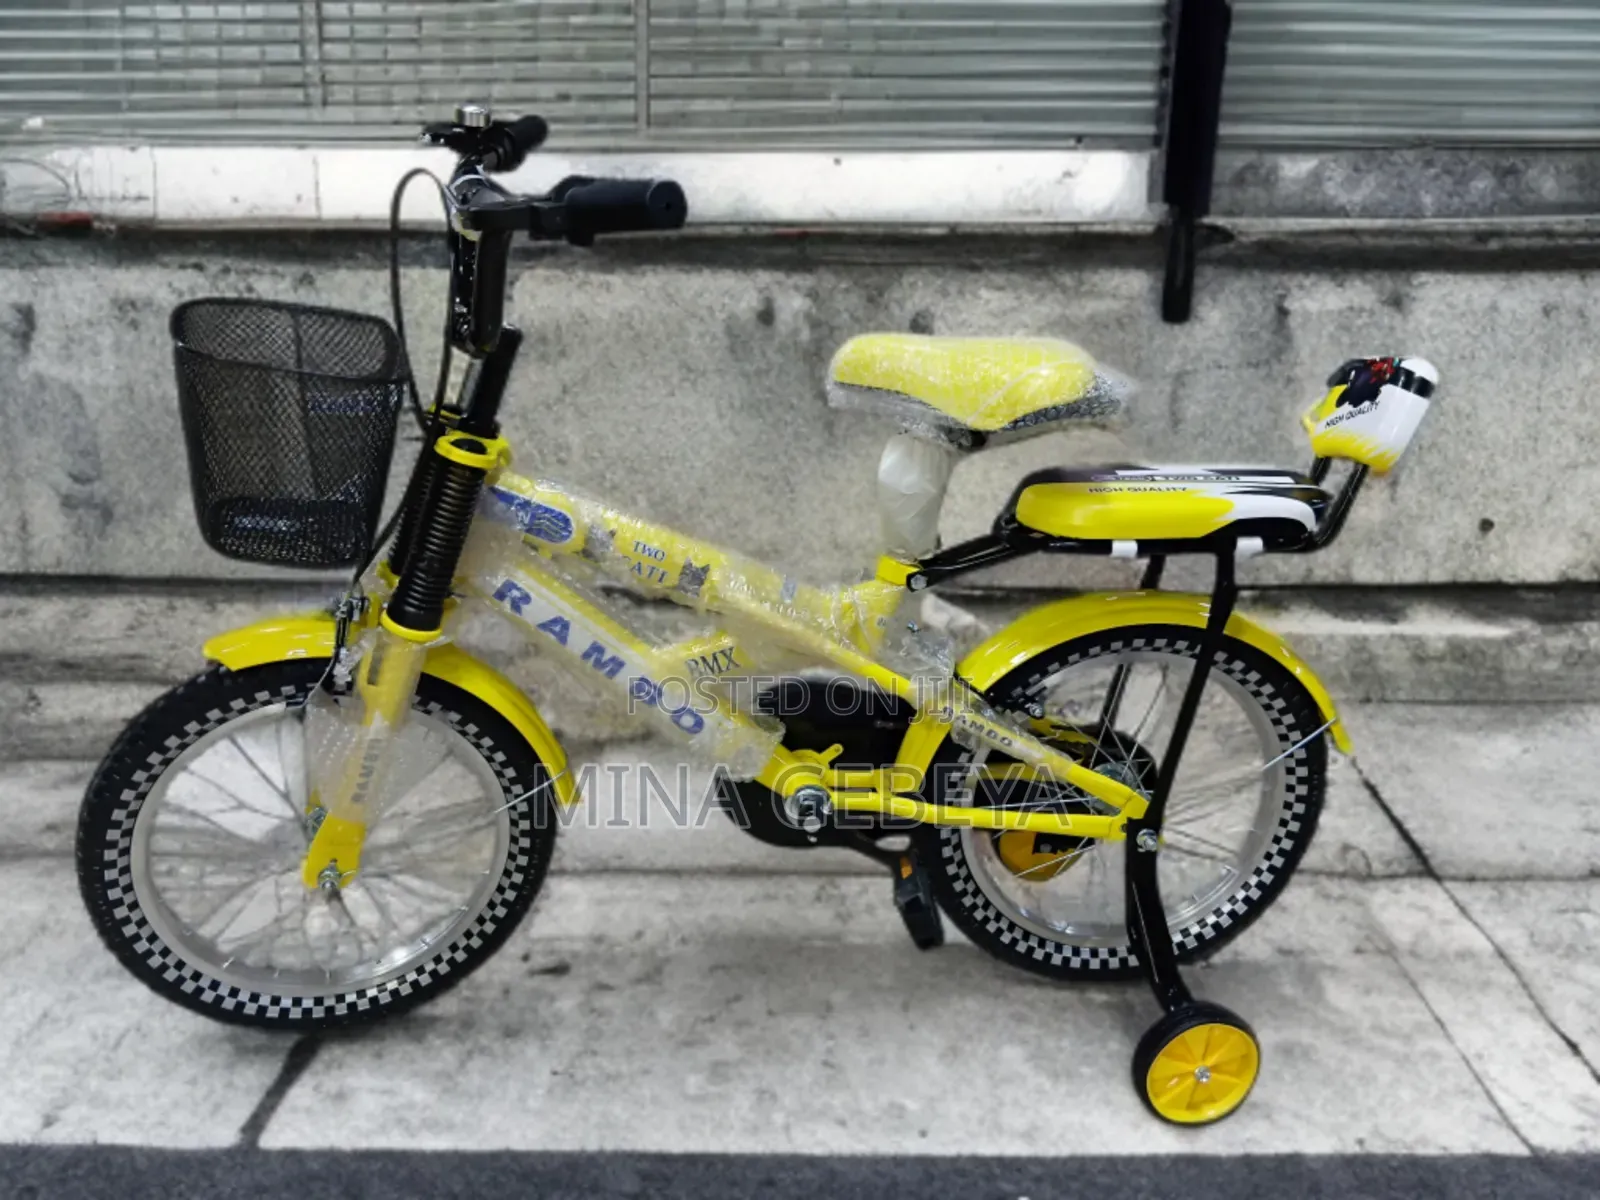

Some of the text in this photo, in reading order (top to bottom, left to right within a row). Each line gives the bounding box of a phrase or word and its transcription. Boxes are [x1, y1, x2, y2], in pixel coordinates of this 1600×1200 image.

[1325, 400, 1381, 429] HIGH QUALITY
[1088, 486, 1123, 494] HIGH
[633, 540, 666, 562] TWO
[622, 555, 668, 584] ATI
[492, 578, 705, 734] RAMBO
